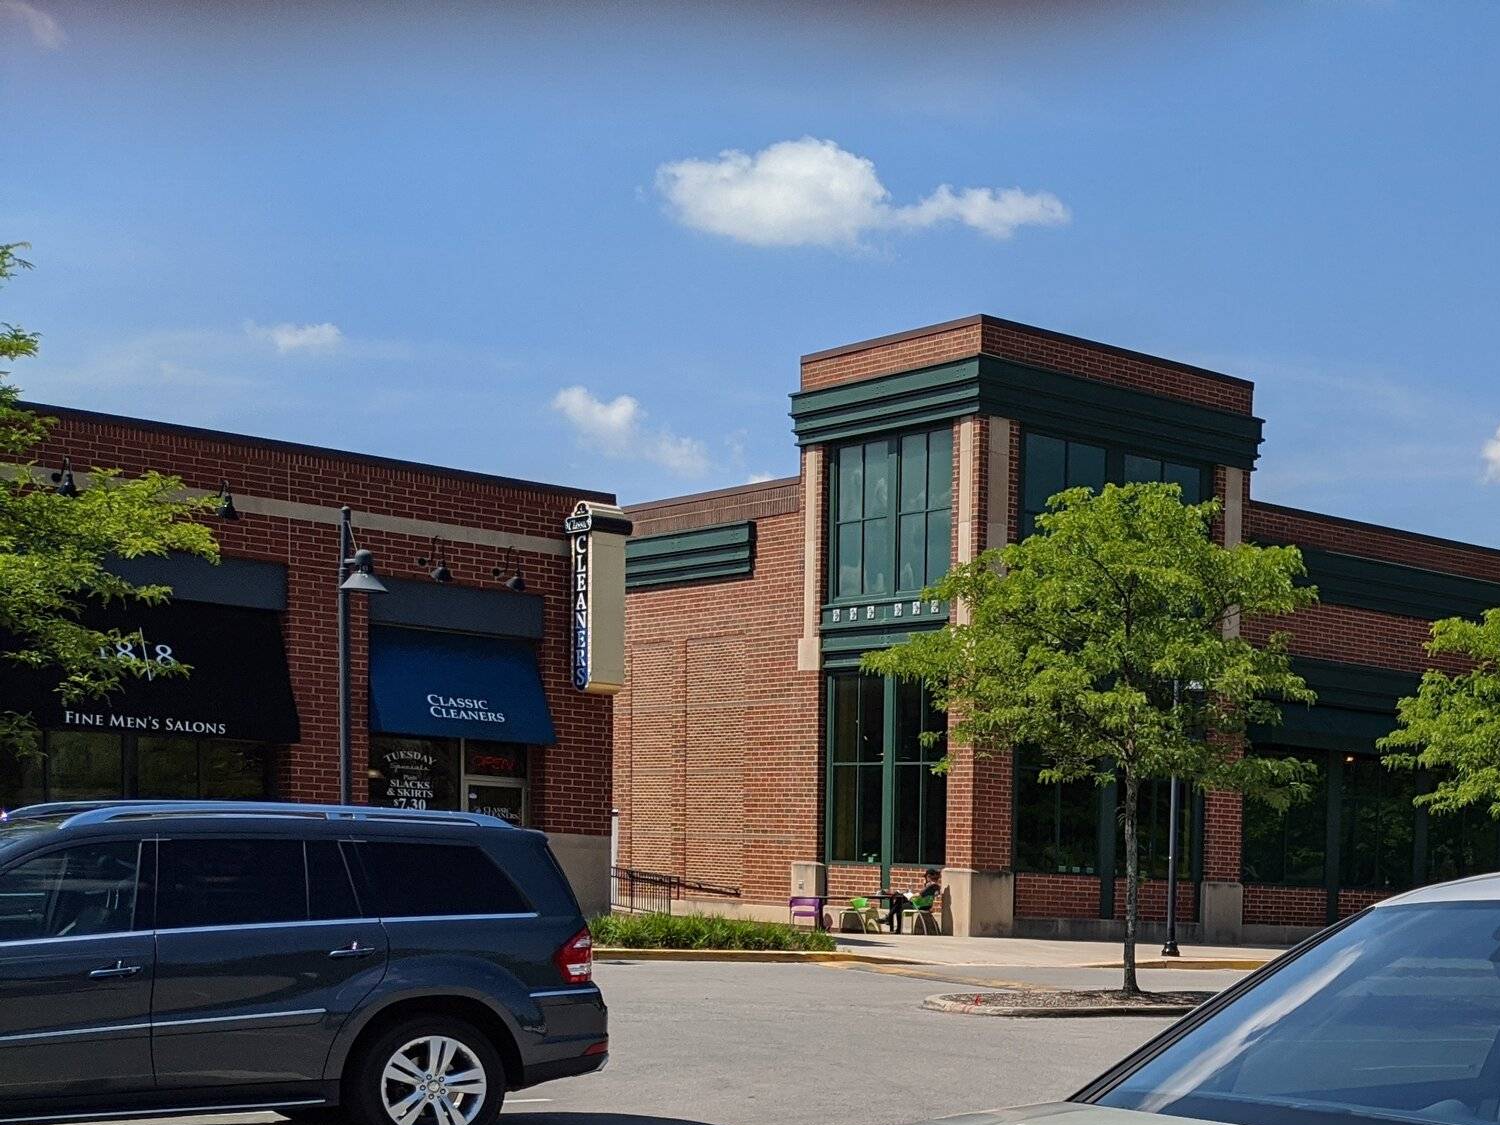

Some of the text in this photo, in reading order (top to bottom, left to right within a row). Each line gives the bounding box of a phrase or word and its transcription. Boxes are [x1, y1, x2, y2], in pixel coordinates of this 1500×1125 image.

[575, 535, 587, 686] CLEANERS
[427, 694, 489, 710] CLASSIC
[429, 706, 505, 723] CLEANERS
[65, 711, 226, 735] FINE MEN'S SALONS
[383, 751, 437, 765] TUESDAY
[386, 787, 434, 798] & SKIRTS
[390, 779, 431, 790] SLACKS
